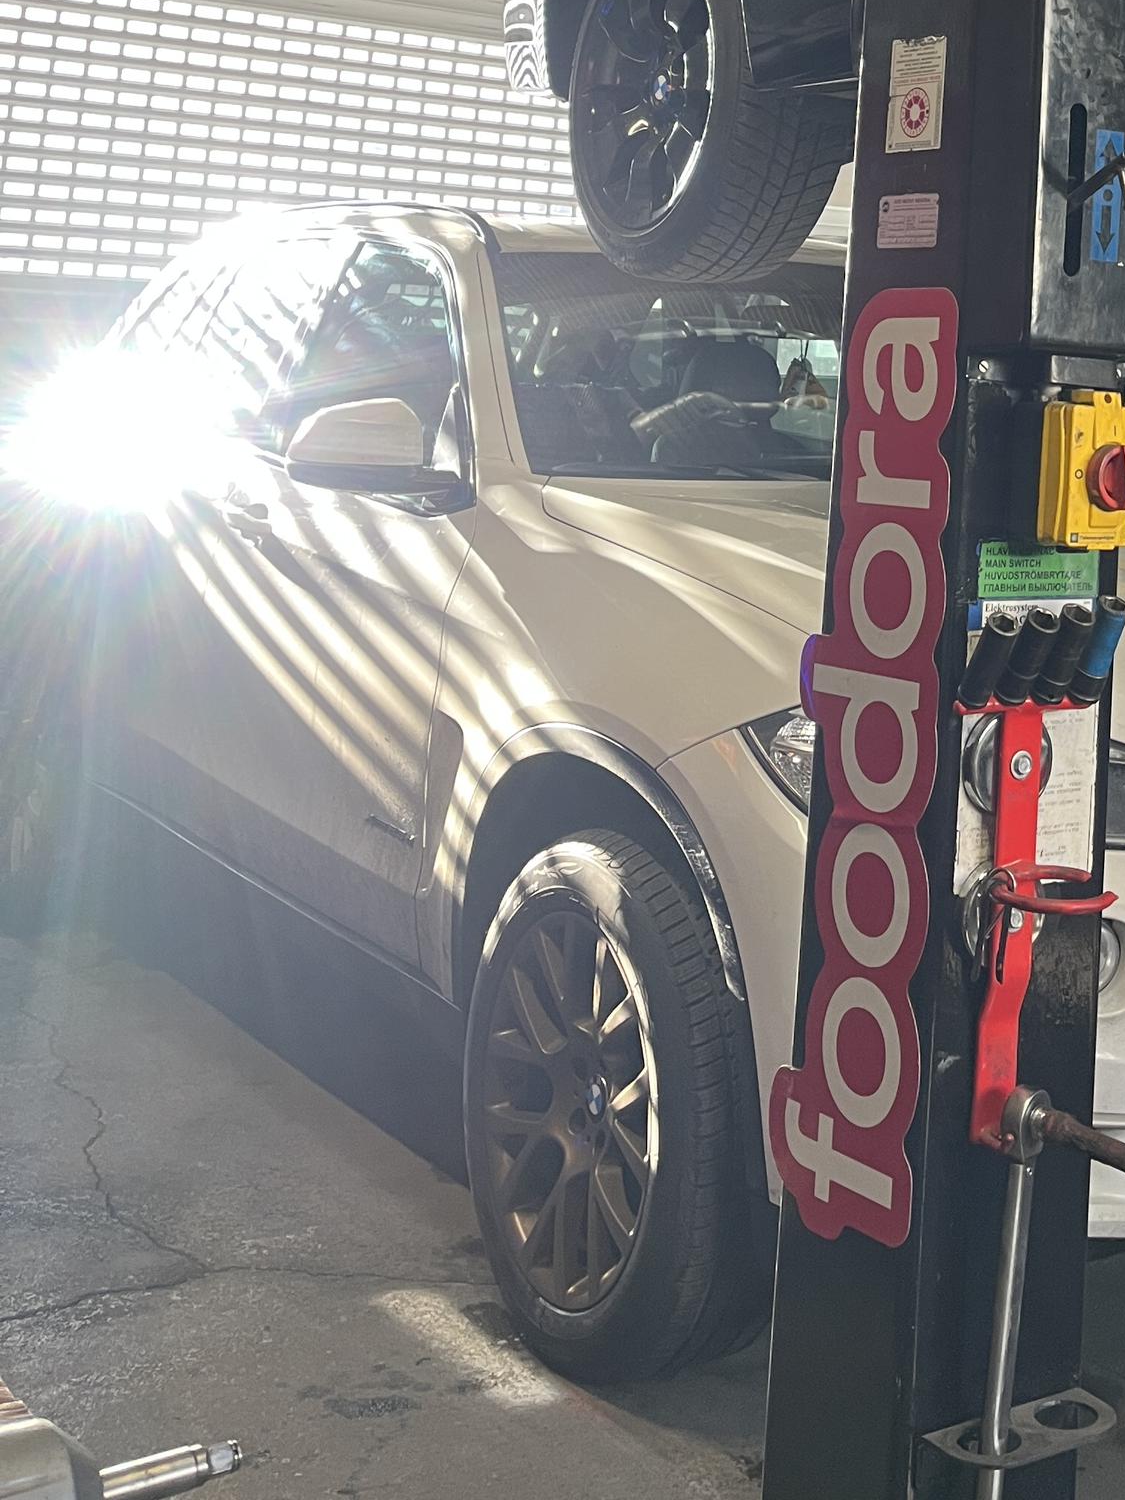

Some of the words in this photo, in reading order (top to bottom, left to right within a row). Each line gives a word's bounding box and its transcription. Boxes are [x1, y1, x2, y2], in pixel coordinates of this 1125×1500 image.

[785, 316, 940, 1210] foodora
[985, 559, 1006, 568] MAIN
[1009, 558, 1041, 568] SWITCH
